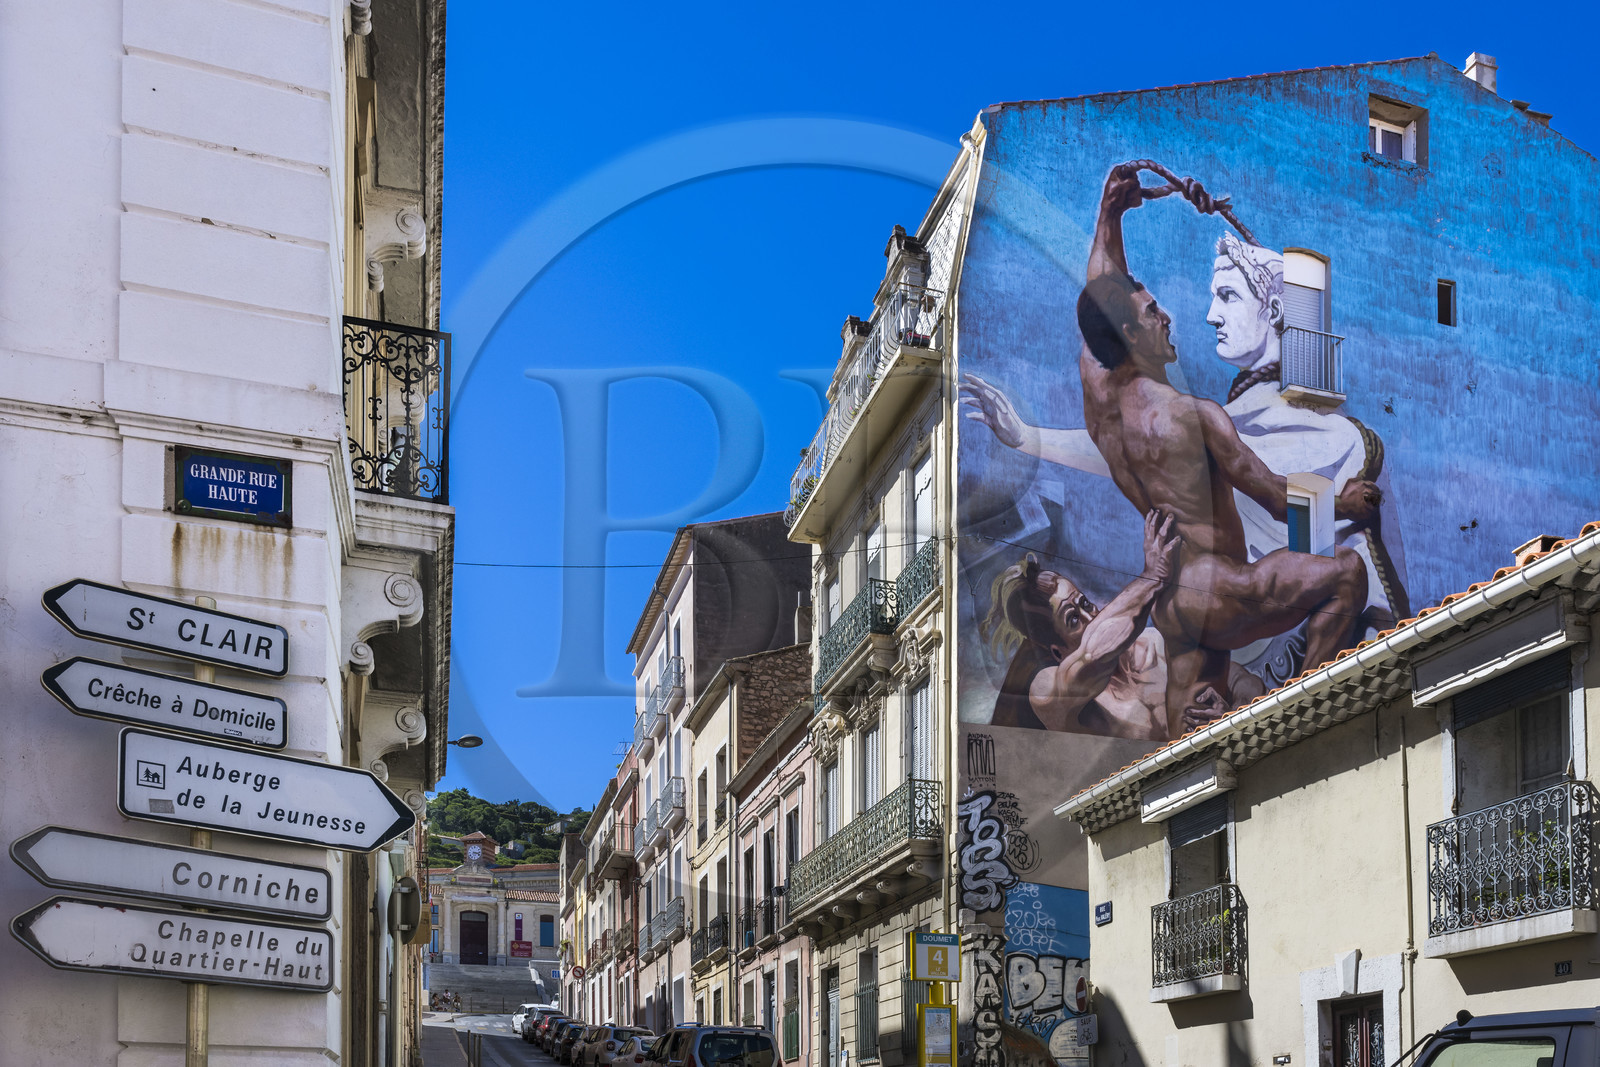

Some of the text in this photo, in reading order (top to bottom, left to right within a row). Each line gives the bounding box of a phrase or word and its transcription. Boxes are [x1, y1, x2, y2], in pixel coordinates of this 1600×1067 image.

[190, 463, 277, 489] GRANDE RUE
[208, 484, 258, 505] HAUTE
[177, 618, 273, 660] CLAIR
[87, 678, 276, 731] Crêche à Domicile
[176, 756, 281, 792] Auberge
[176, 788, 366, 835] de la Jeunesse
[172, 862, 319, 904] Corniche
[158, 920, 323, 956] Chapelle du
[130, 943, 323, 980] Quartier-Haut
[933, 950, 943, 964] 4
[1558, 963, 1569, 973] 40
[1080, 1016, 1092, 1026] SAUF
